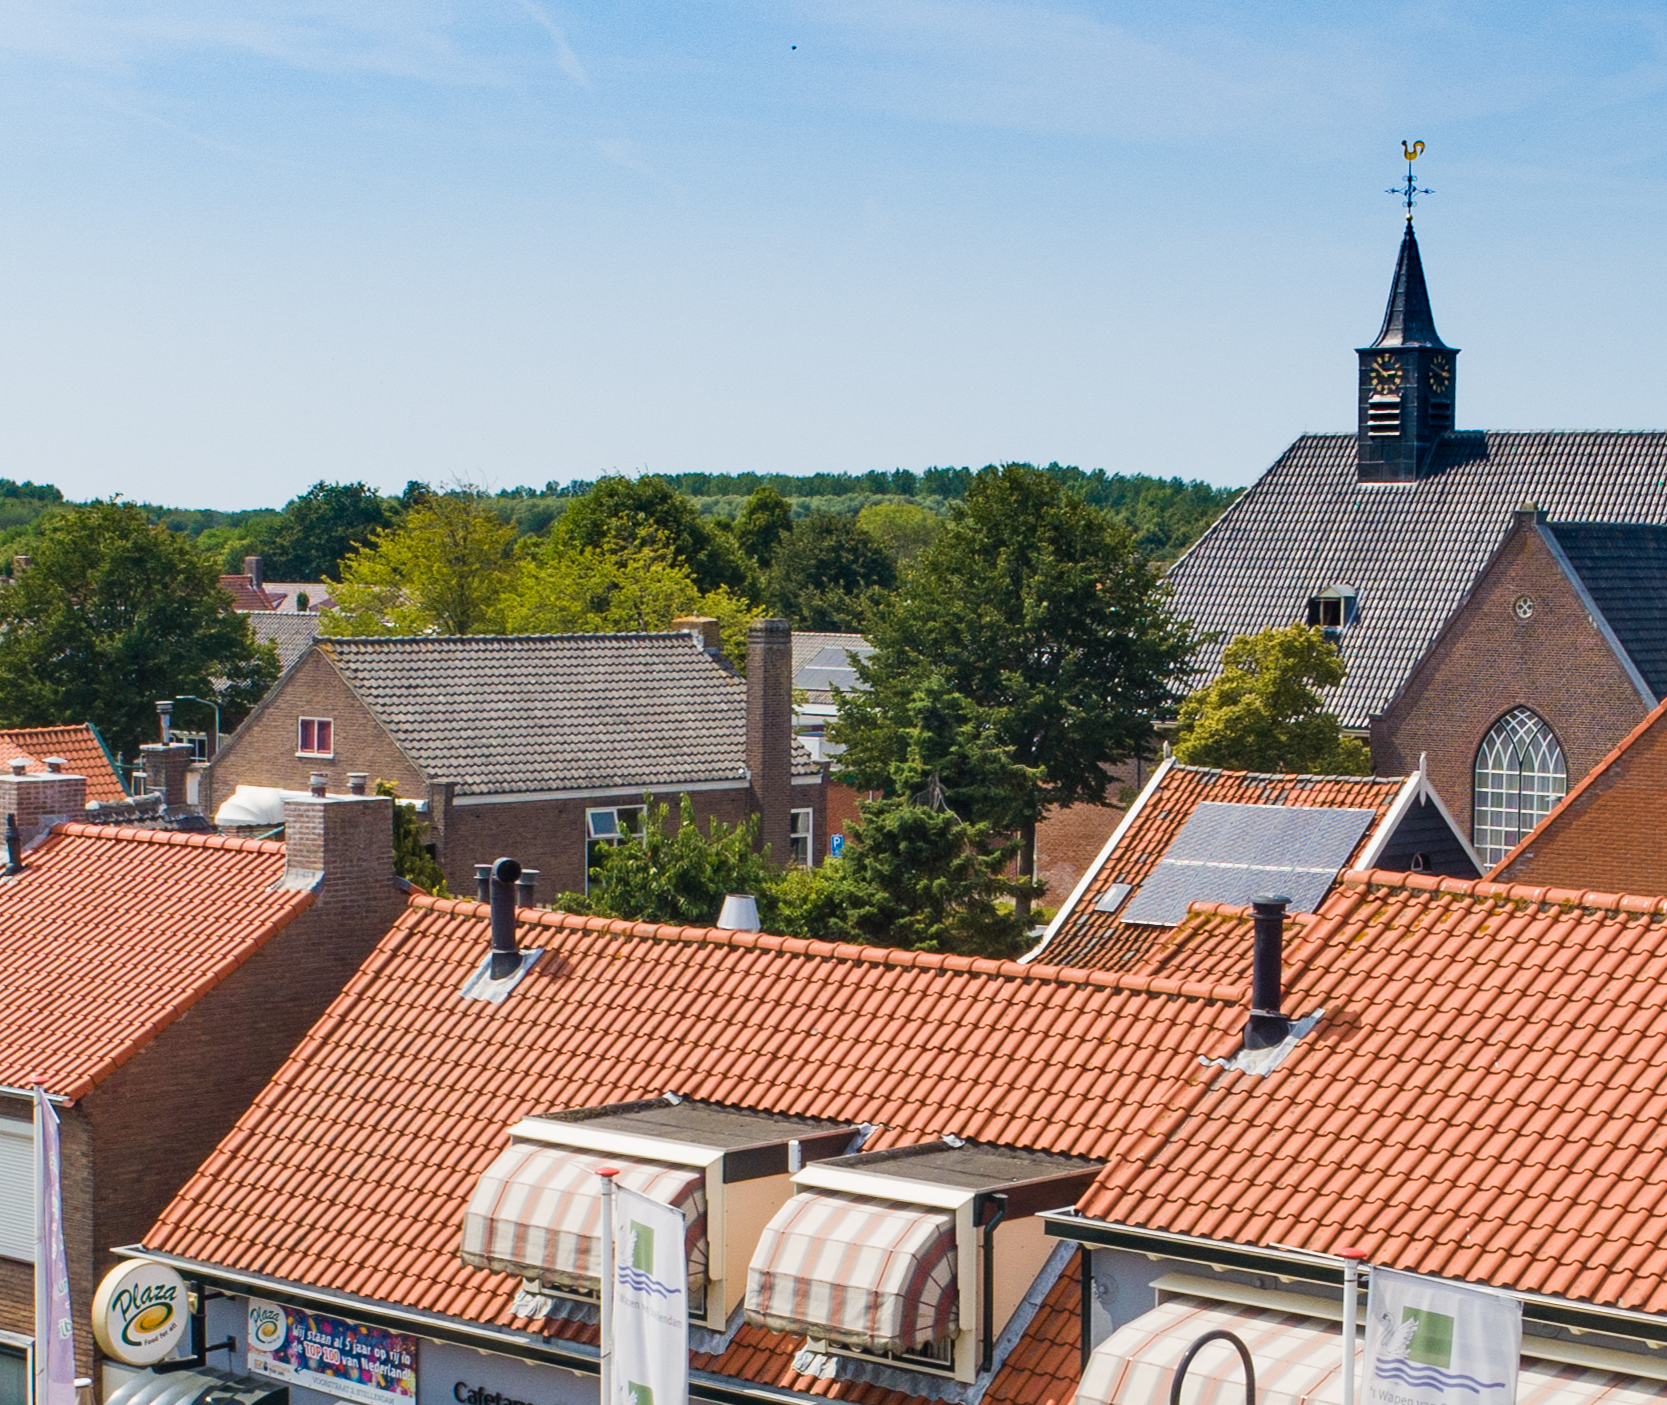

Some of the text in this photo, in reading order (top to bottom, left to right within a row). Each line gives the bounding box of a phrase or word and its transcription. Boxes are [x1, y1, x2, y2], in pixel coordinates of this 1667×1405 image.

[111, 1283, 179, 1322] Plaza
[249, 1306, 280, 1327] Plaza
[304, 1342, 322, 1358] TOP
[323, 1348, 340, 1365] 100
[341, 1355, 359, 1369] van
[361, 1357, 411, 1380] Nederland!
[306, 1330, 332, 1345] staan
[333, 1335, 343, 1349] al
[352, 1340, 371, 1356] jaar
[374, 1347, 387, 1361] op
[400, 1351, 411, 1365] in
